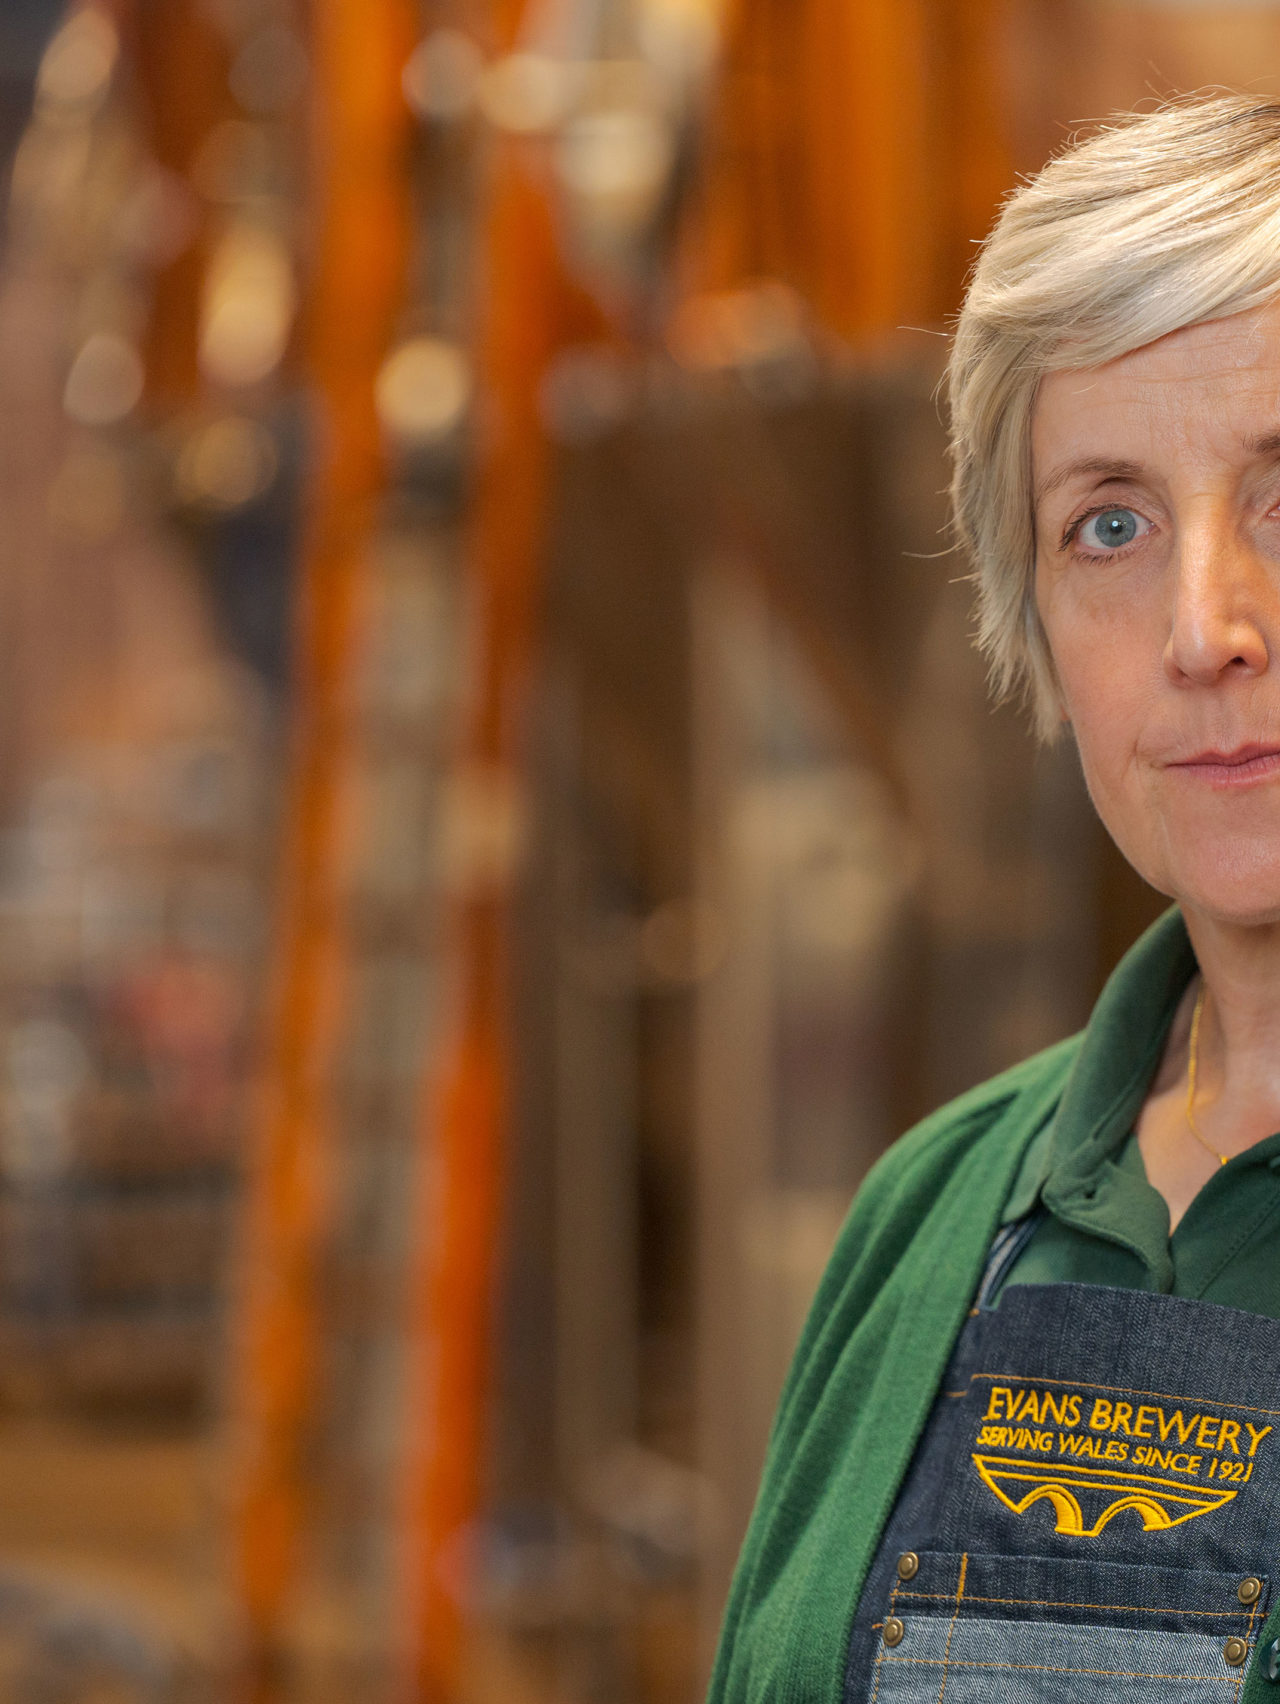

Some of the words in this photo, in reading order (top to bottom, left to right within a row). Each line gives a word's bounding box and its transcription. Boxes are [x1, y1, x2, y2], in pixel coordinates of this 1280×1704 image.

[981, 1386, 1083, 1427] EVANS
[1089, 1398, 1273, 1457] BREWERY
[976, 1425, 1054, 1453] SERVING
[1058, 1432, 1130, 1461] WALES
[1131, 1446, 1202, 1476] SINCE
[1207, 1457, 1253, 1483] 1921
